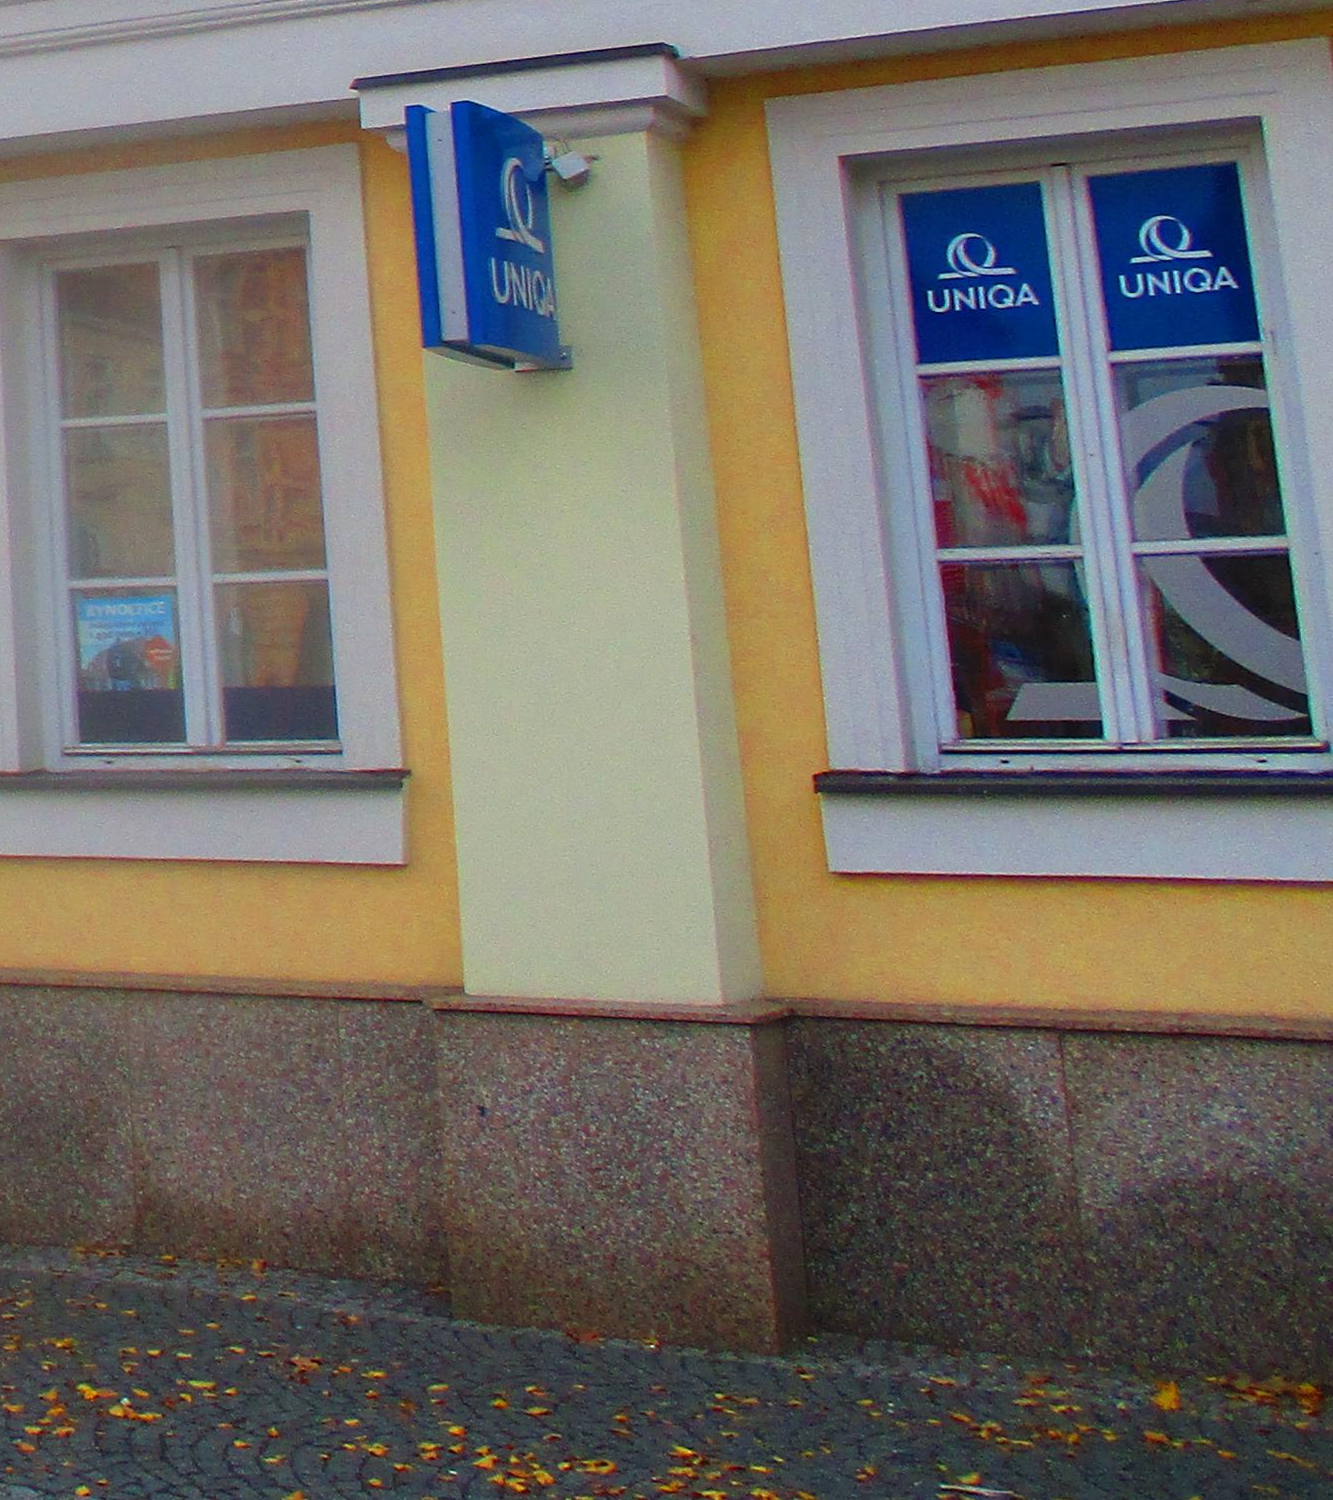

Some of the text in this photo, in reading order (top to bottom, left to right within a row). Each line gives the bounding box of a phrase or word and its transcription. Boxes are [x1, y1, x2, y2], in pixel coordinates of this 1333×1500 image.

[490, 257, 556, 320] UNIQA
[927, 282, 1040, 314] UNIQA
[1118, 265, 1238, 299] UNIQA
